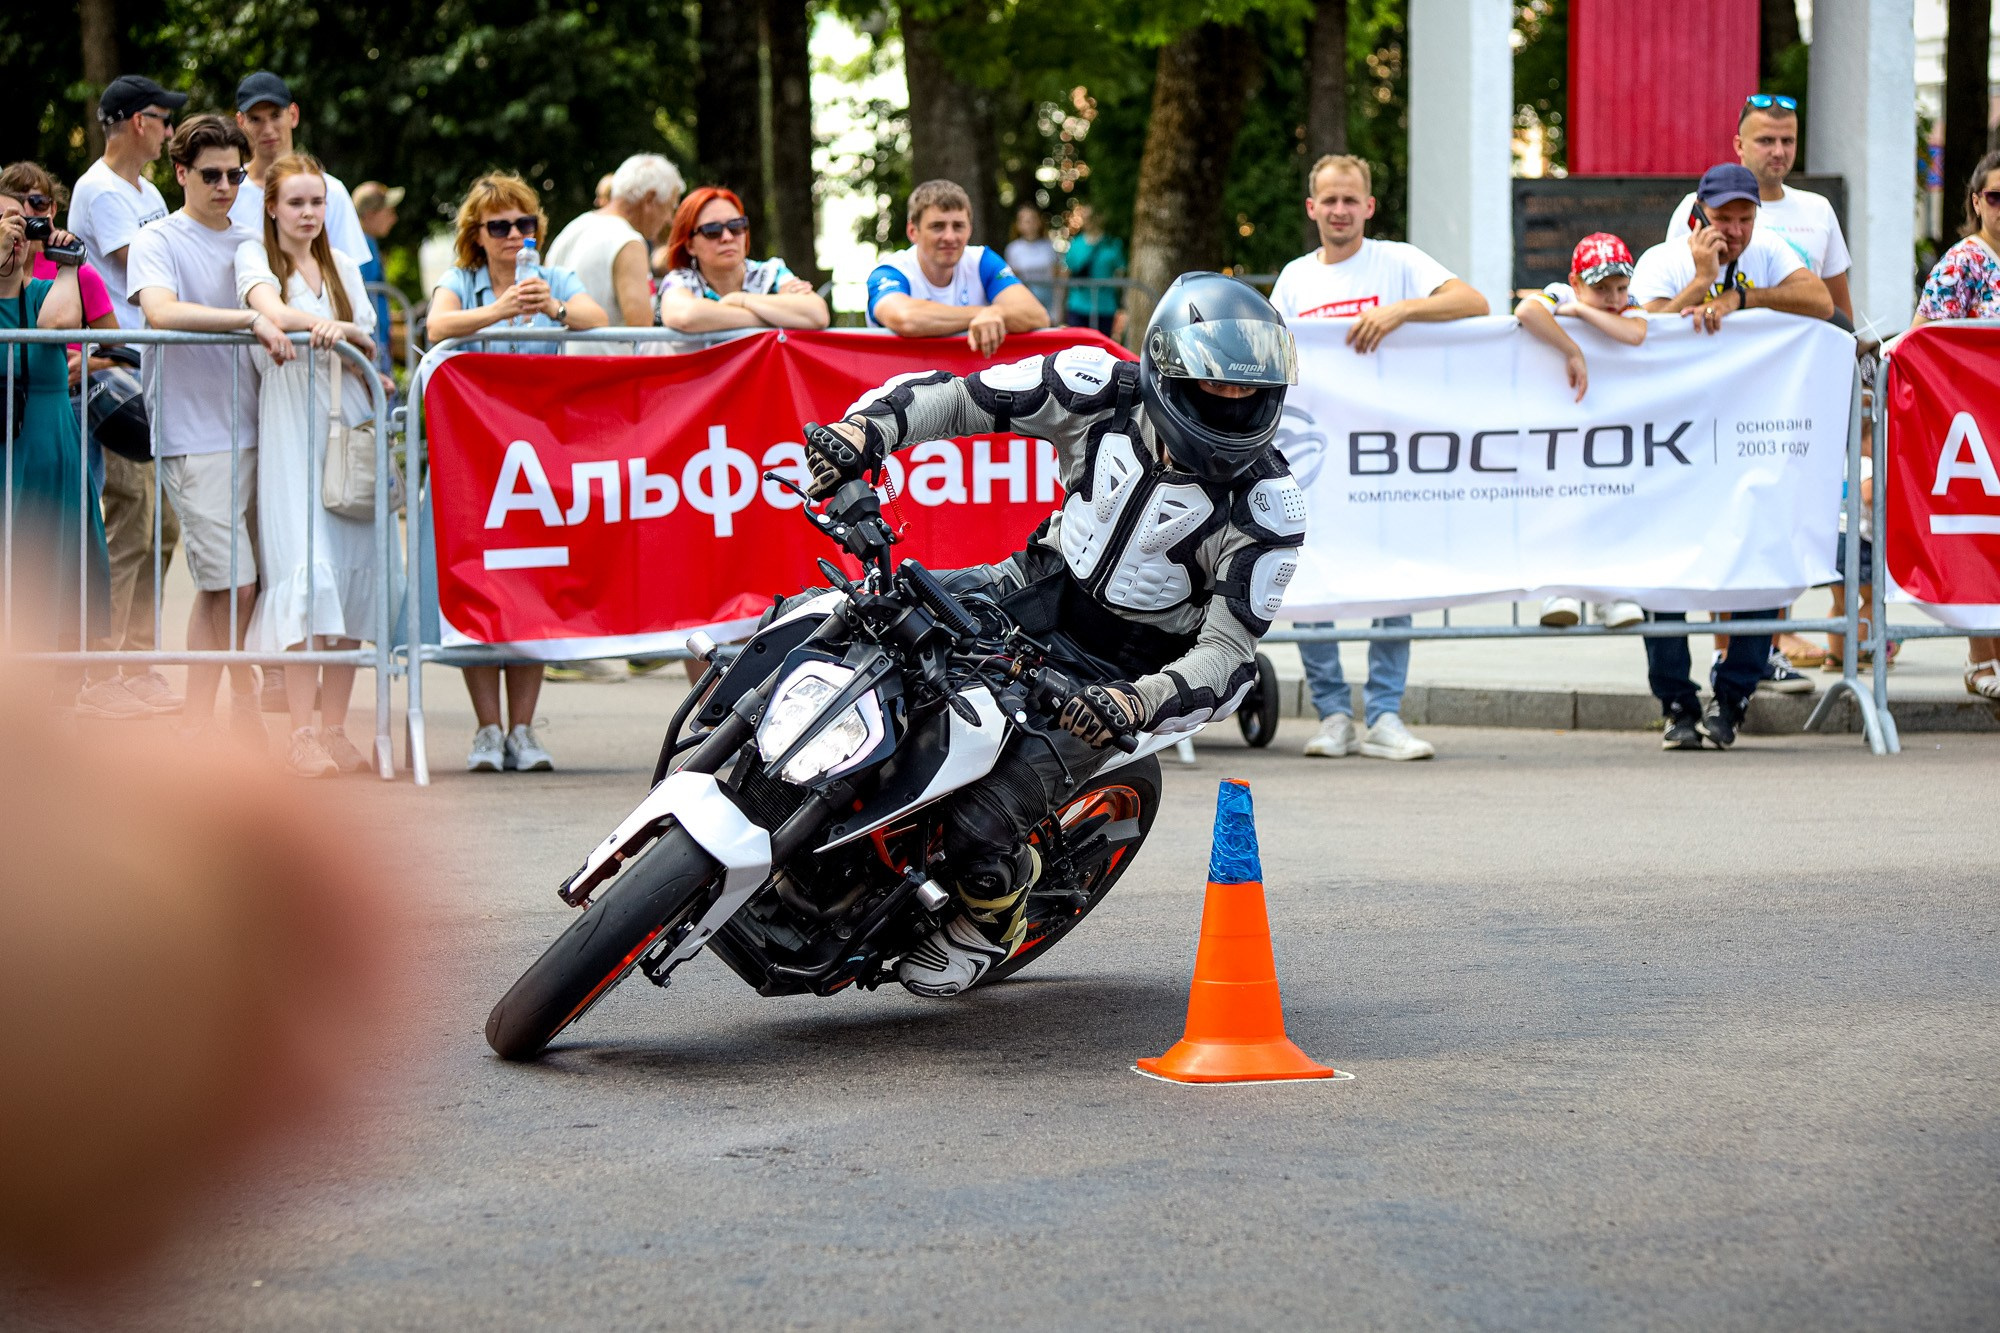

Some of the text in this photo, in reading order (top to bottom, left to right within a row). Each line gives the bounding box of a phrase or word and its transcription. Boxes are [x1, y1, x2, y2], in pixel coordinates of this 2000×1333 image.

[1074, 371, 1104, 386] FOX
[1227, 362, 1267, 377] NOLAN
[1349, 421, 1693, 475] ВОСТОК
[1737, 439, 1810, 458] 2003 году
[1349, 482, 1636, 504] комплексные охранные системы
